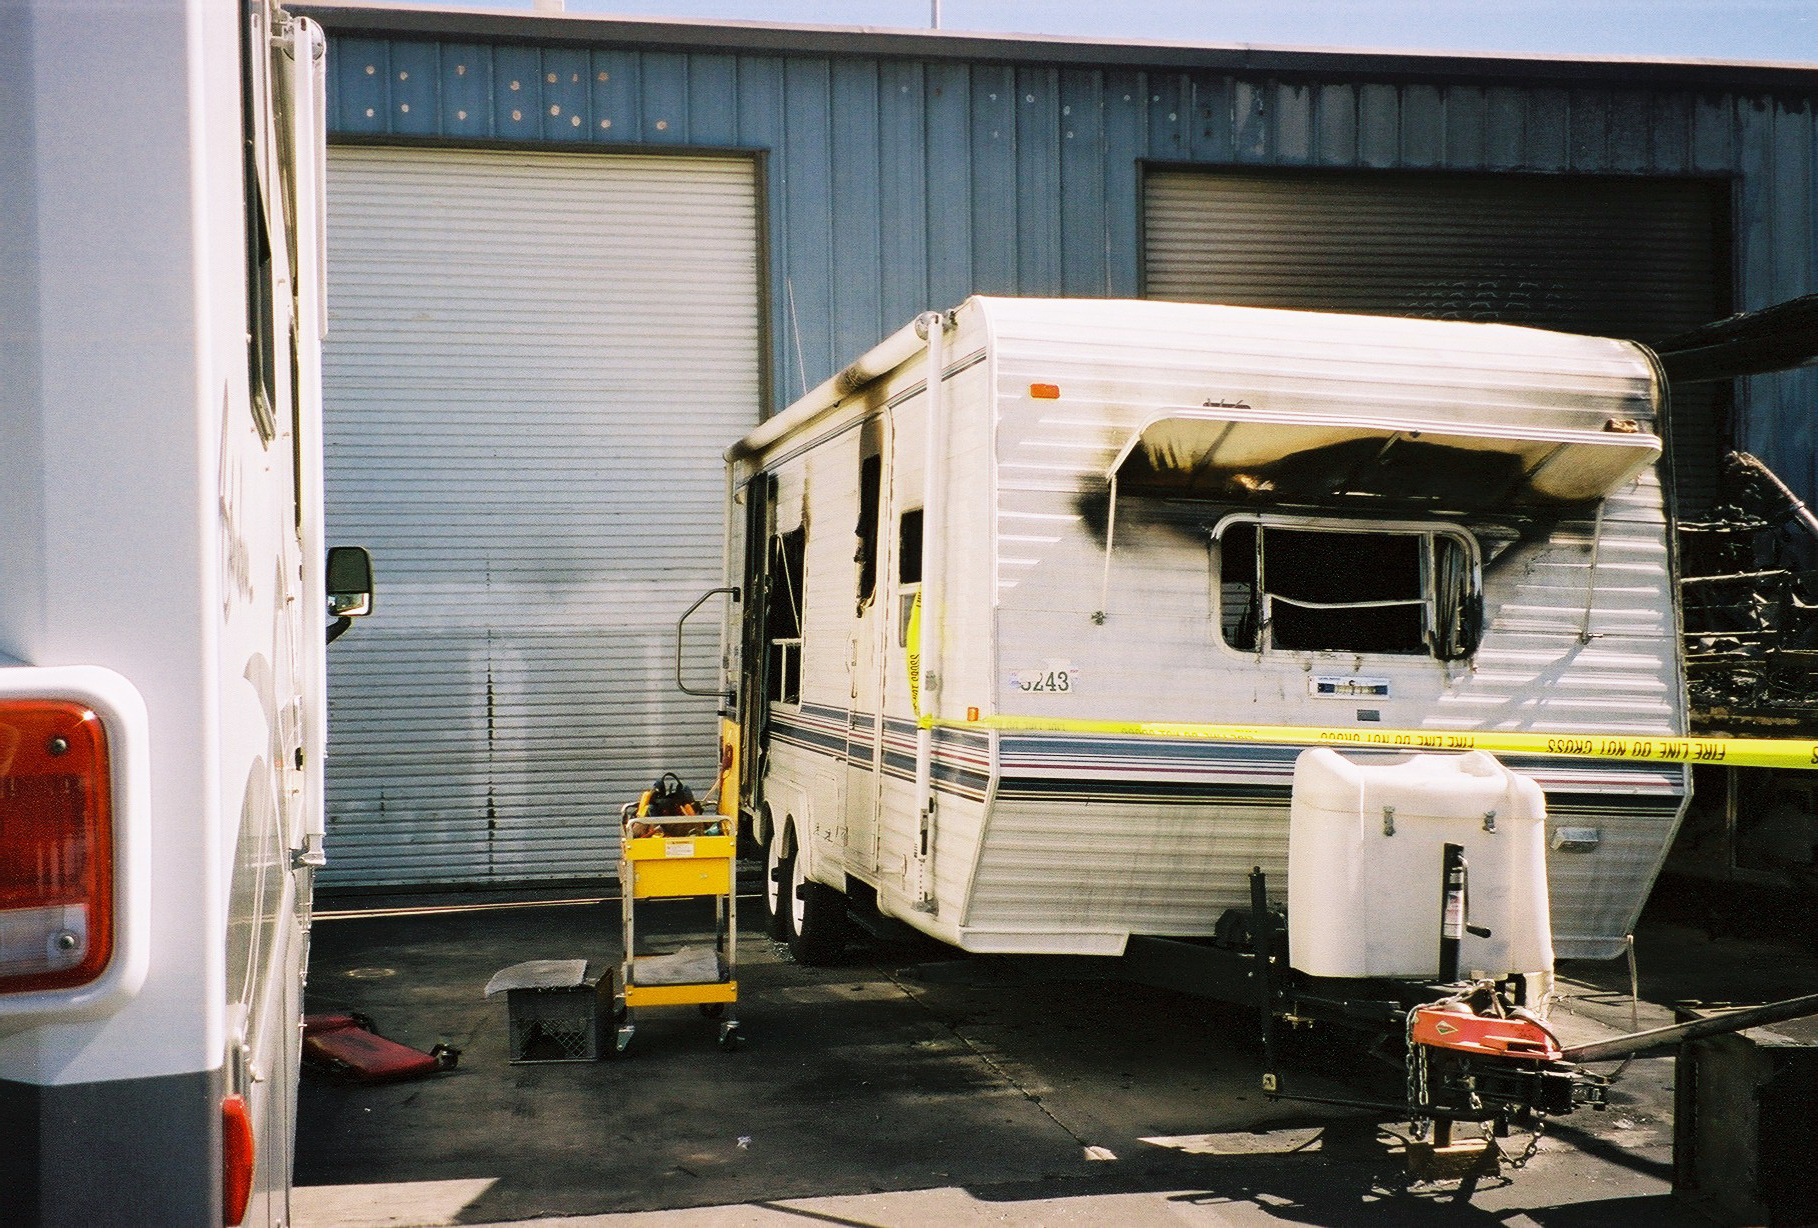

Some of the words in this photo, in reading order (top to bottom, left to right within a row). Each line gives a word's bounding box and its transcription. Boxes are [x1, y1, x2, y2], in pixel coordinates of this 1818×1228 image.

[1545, 738, 1593, 755] CROSS
[1600, 740, 1627, 757] NOT
[1631, 741, 1652, 758] DO
[1659, 742, 1689, 760] LINE
[1693, 743, 1726, 761] FIRE
